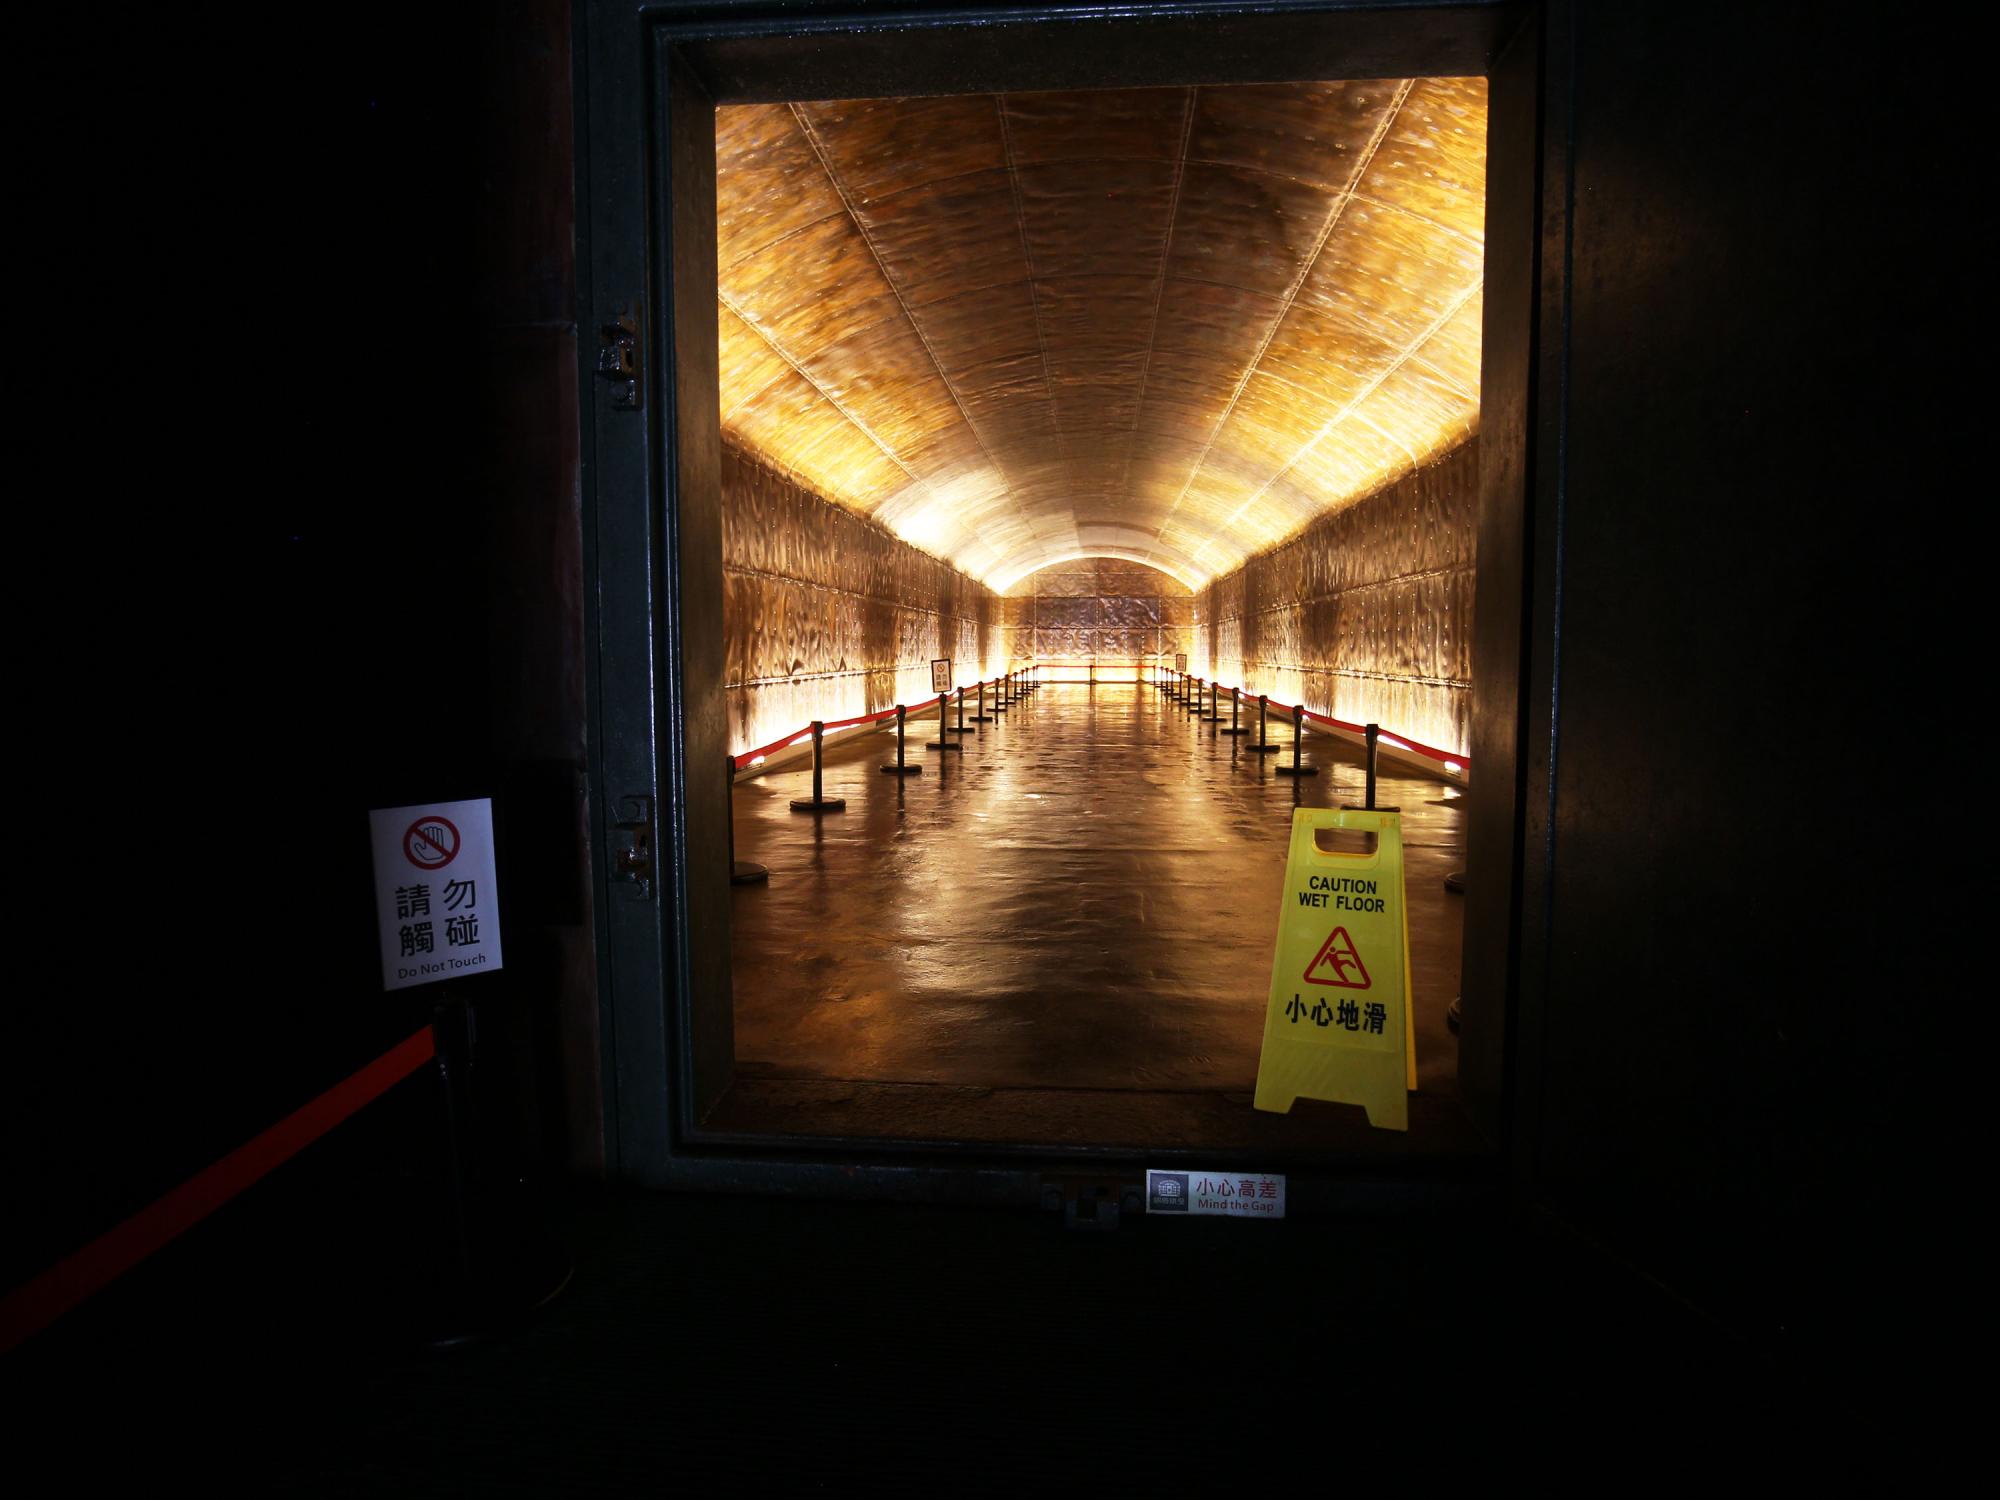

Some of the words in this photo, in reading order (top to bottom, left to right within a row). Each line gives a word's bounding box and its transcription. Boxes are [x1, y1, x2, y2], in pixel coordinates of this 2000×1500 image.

[1309, 875, 1377, 895] CAUTION
[395, 879, 475, 919] 請勿
[1299, 892, 1330, 908] WET
[1336, 895, 1385, 913] FLOOR
[398, 914, 480, 956] 觸碰
[398, 967, 417, 979] Do
[420, 962, 445, 976] Not
[448, 953, 486, 969] Touch
[1285, 993, 1387, 1035] 小心地滑
[1196, 1177, 1277, 1198] 小心高差
[1198, 1199, 1227, 1209] Mind
[1230, 1200, 1249, 1210] the
[1251, 1201, 1274, 1213] Gap
